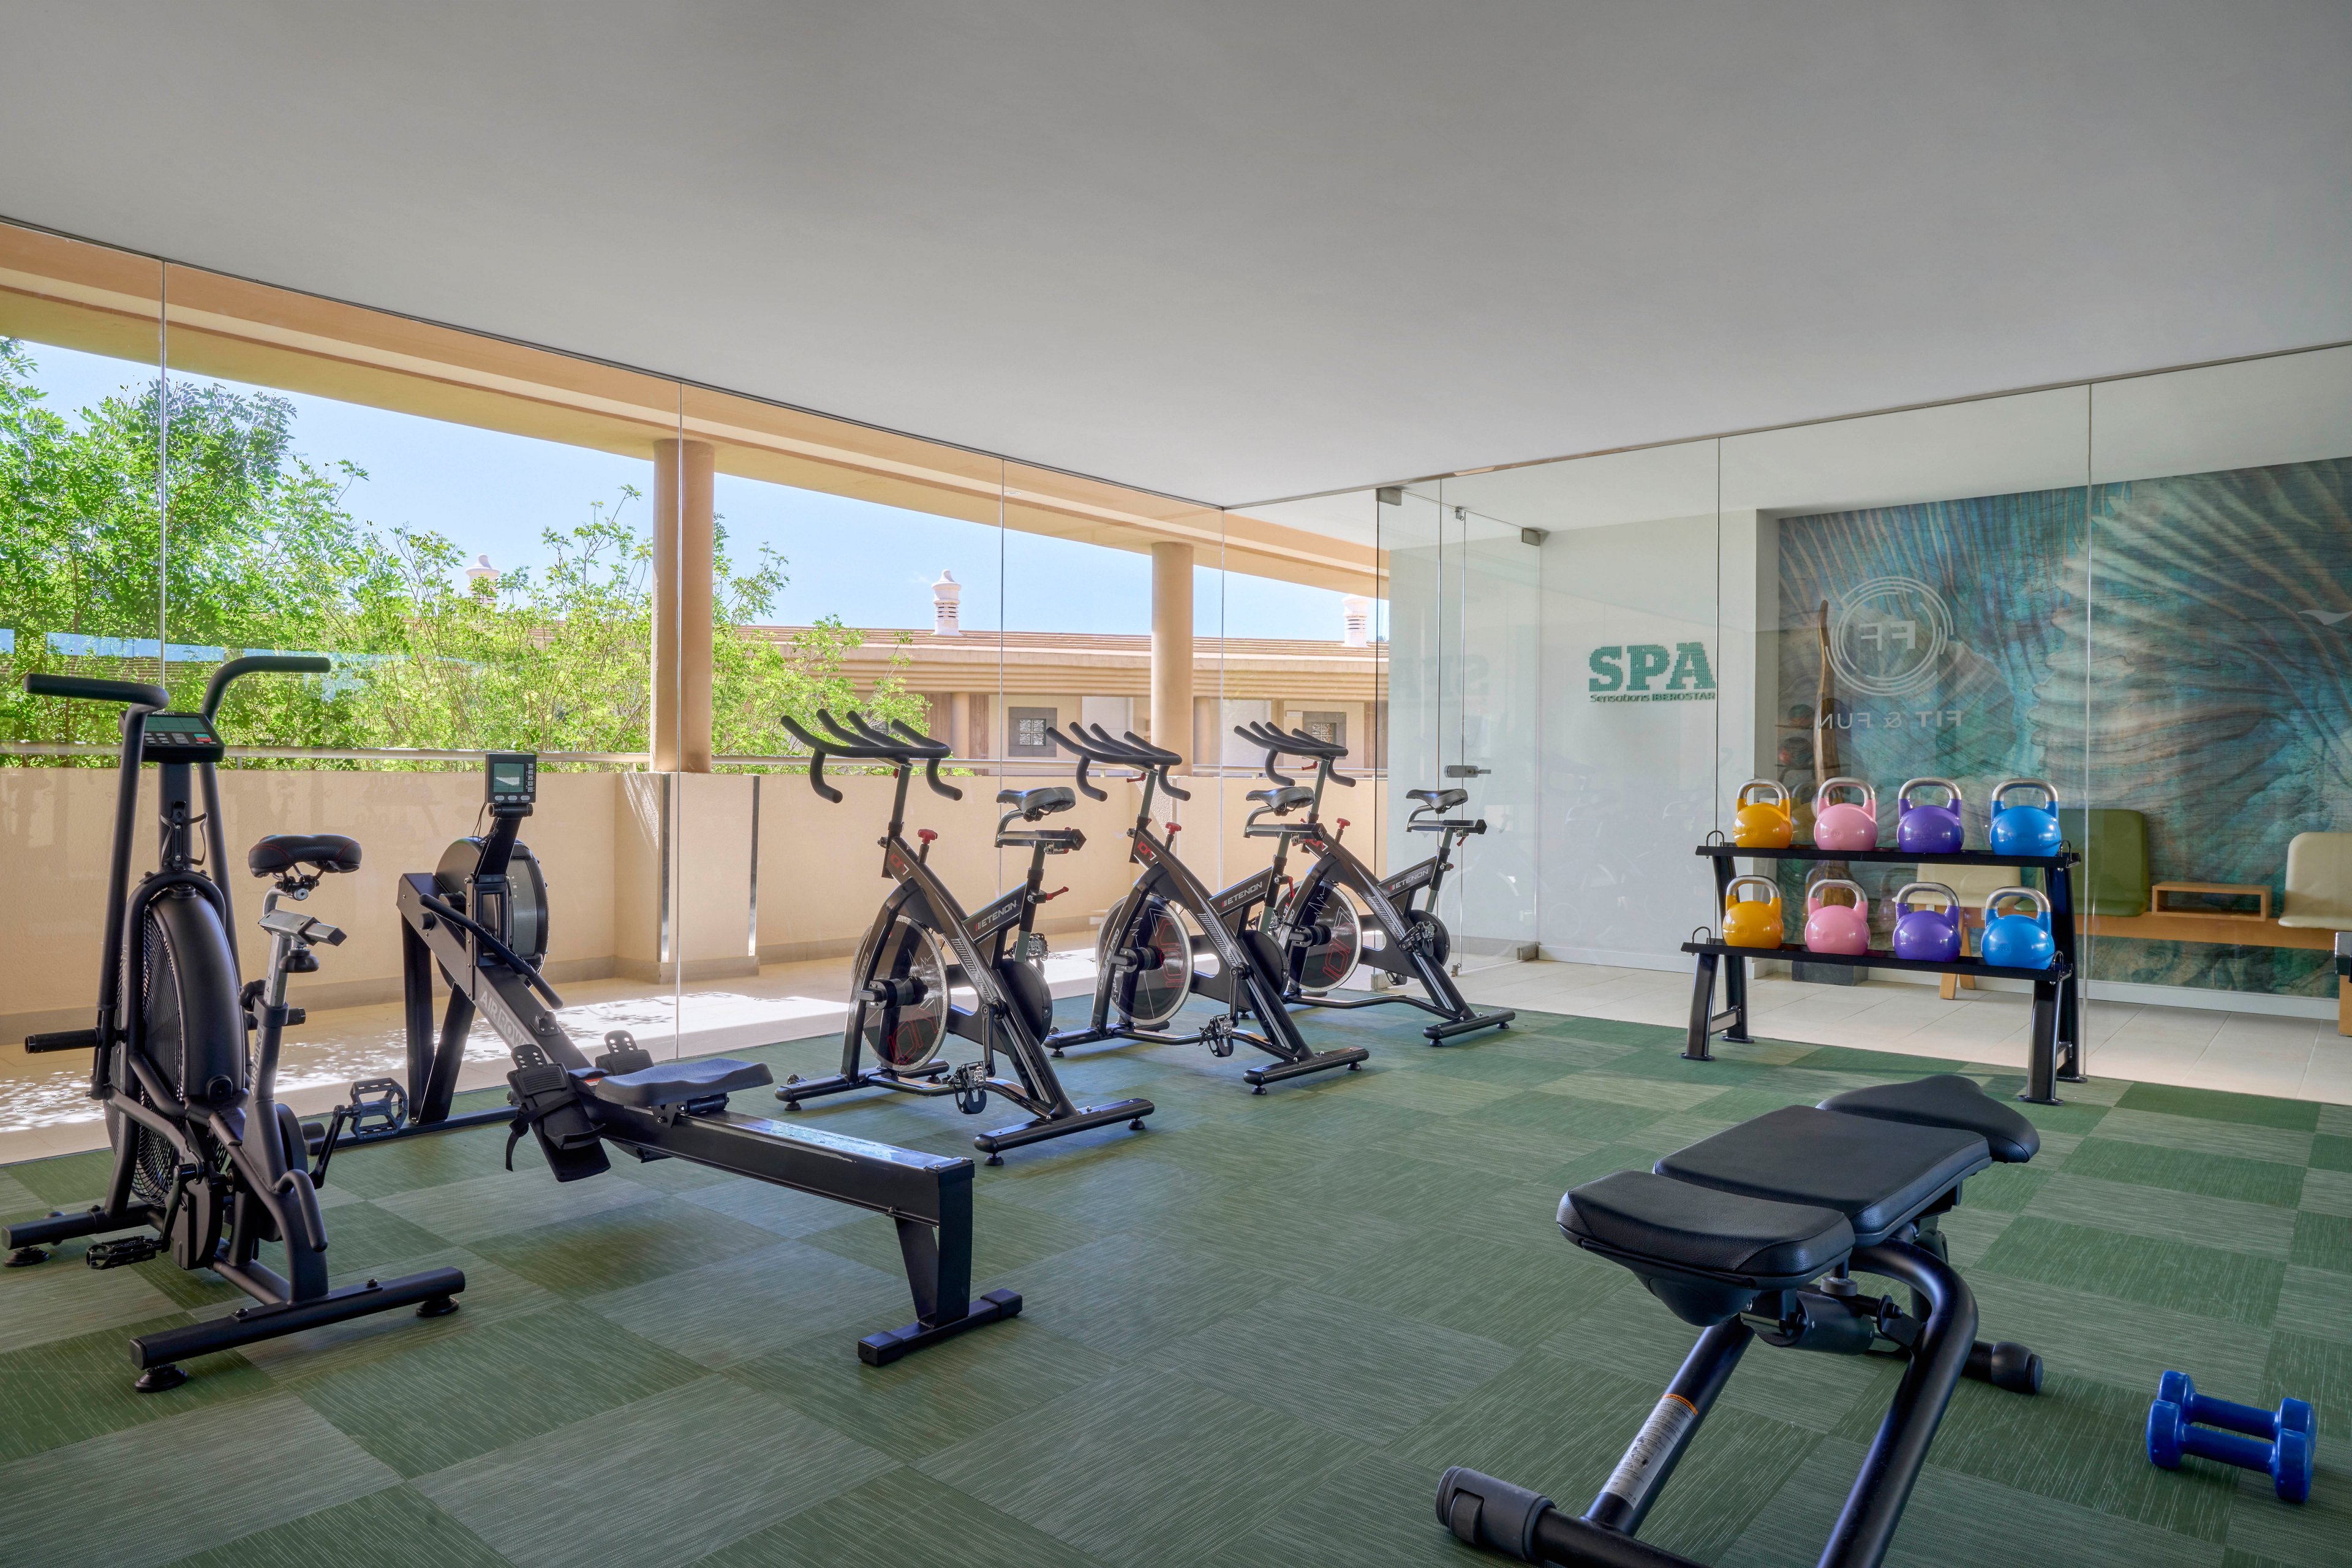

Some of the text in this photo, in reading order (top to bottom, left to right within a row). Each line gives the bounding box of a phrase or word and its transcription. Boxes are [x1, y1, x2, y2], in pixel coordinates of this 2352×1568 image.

[1589, 642, 1716, 692] SPA
[1590, 692, 1716, 703] Sensations IBEROSTAR
[1395, 869, 1428, 889] ETENON
[1227, 881, 1262, 905] ETENON
[981, 899, 1017, 928] ETENON
[1110, 928, 1120, 949] PRO
[859, 951, 869, 978] PRO
[480, 990, 498, 1020] AIR
[250, 1027, 265, 1096] AIR BIKE
[1670, 1394, 1692, 1407] WARNING
